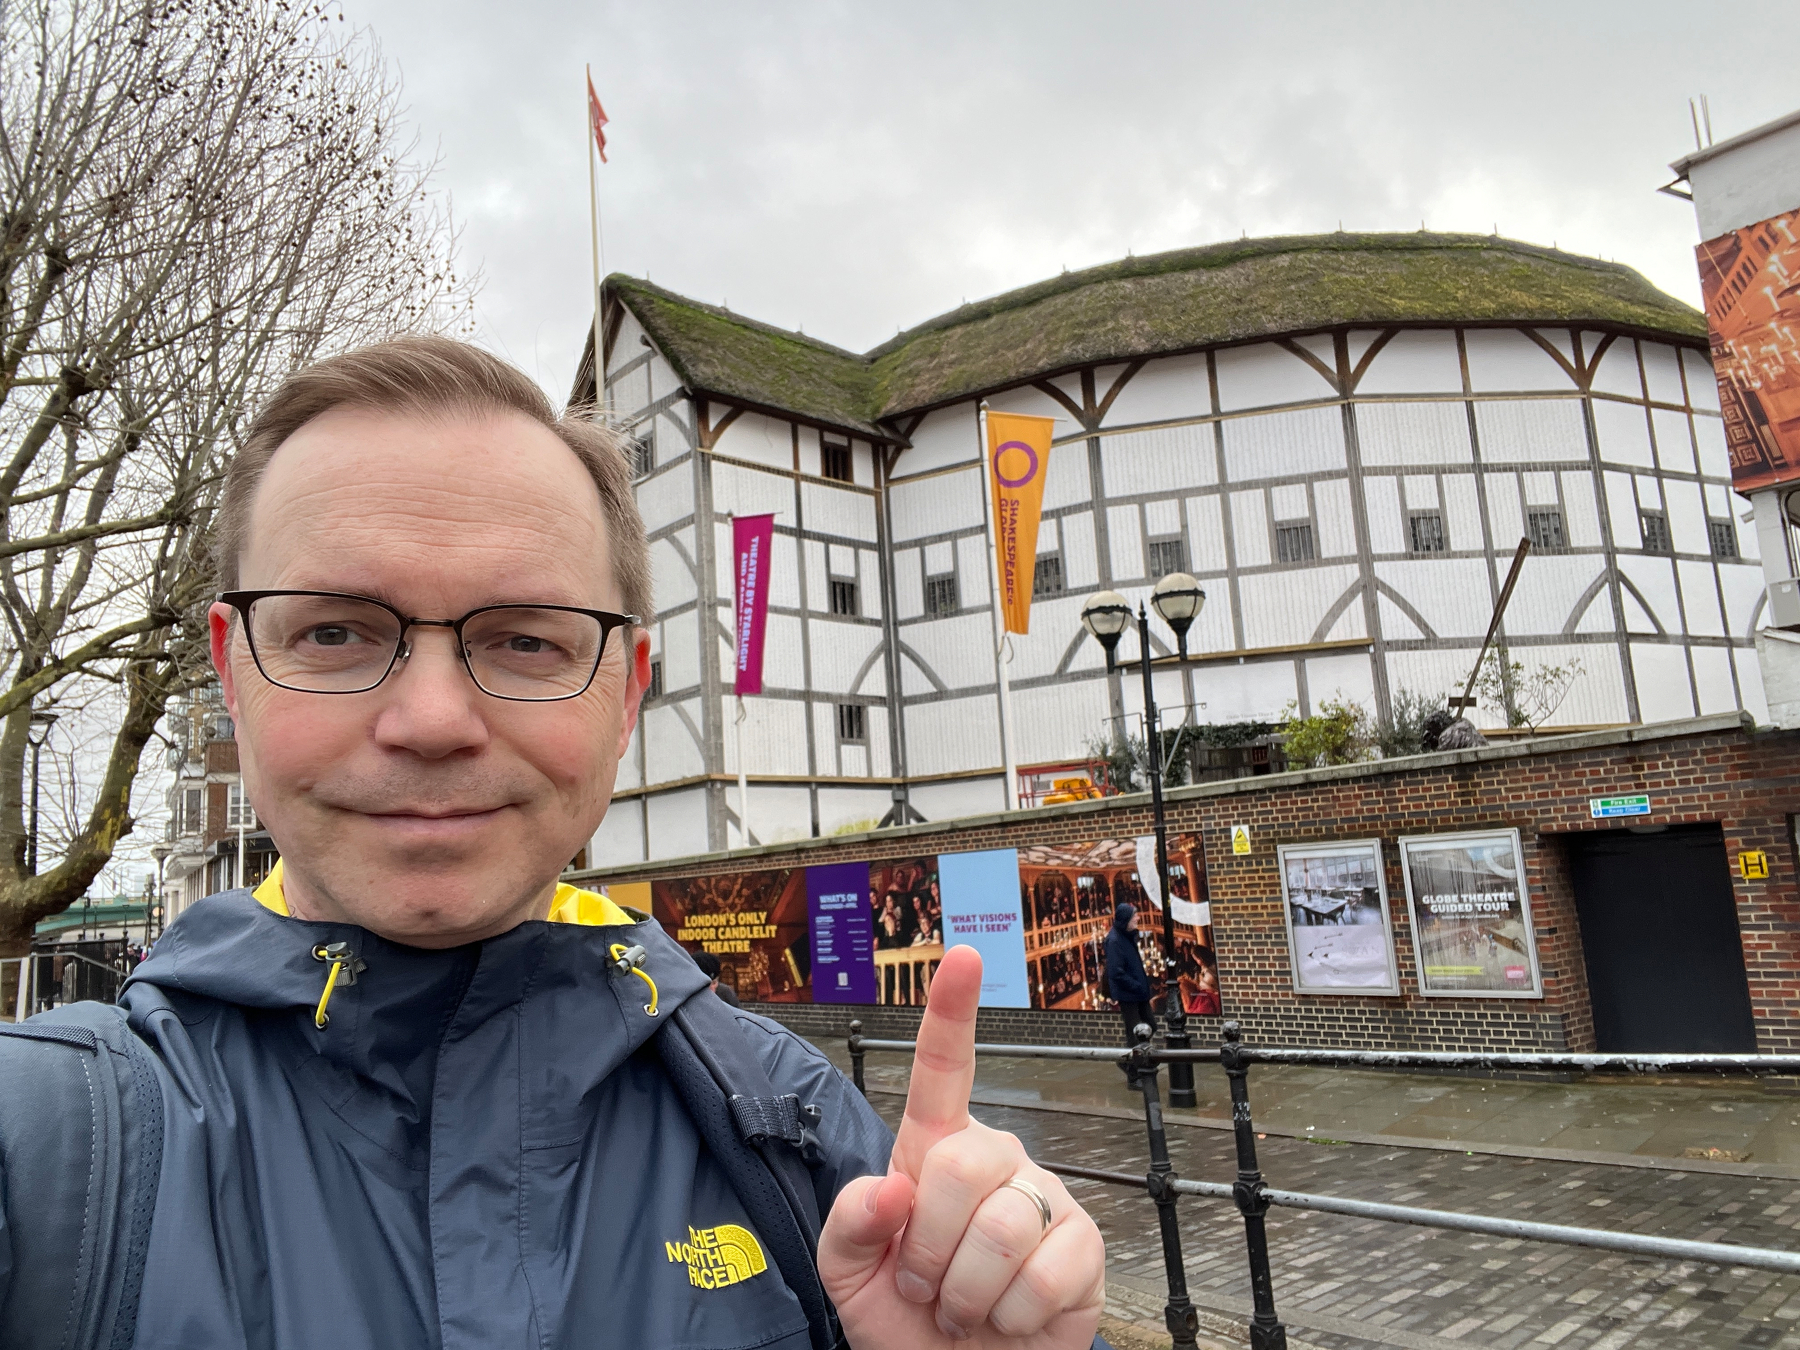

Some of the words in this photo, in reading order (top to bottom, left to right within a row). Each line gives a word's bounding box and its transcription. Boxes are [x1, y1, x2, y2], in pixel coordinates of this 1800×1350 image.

[747, 536, 760, 588] THEATRE
[745, 590, 755, 605] BY
[739, 607, 753, 672] STARLIGHT
[1743, 854, 1764, 875] H
[819, 894, 846, 903] WHAT'S
[847, 893, 858, 902] ON
[1422, 894, 1459, 904] GLOBE
[1460, 892, 1516, 903] THEATRE
[1430, 903, 1473, 913] GUIDED
[1475, 902, 1510, 912] TOUR
[684, 913, 736, 928] LONDON'S
[737, 911, 767, 924] ONLY
[978, 912, 1017, 923] VISIONS
[677, 927, 717, 941] INDOOR
[718, 925, 777, 940] CANDLELIT
[954, 924, 978, 933] HAVE
[701, 940, 751, 953] THEATRE
[688, 1225, 719, 1249] THE
[665, 1241, 724, 1268] NORTH
[688, 1264, 730, 1290] FACE
